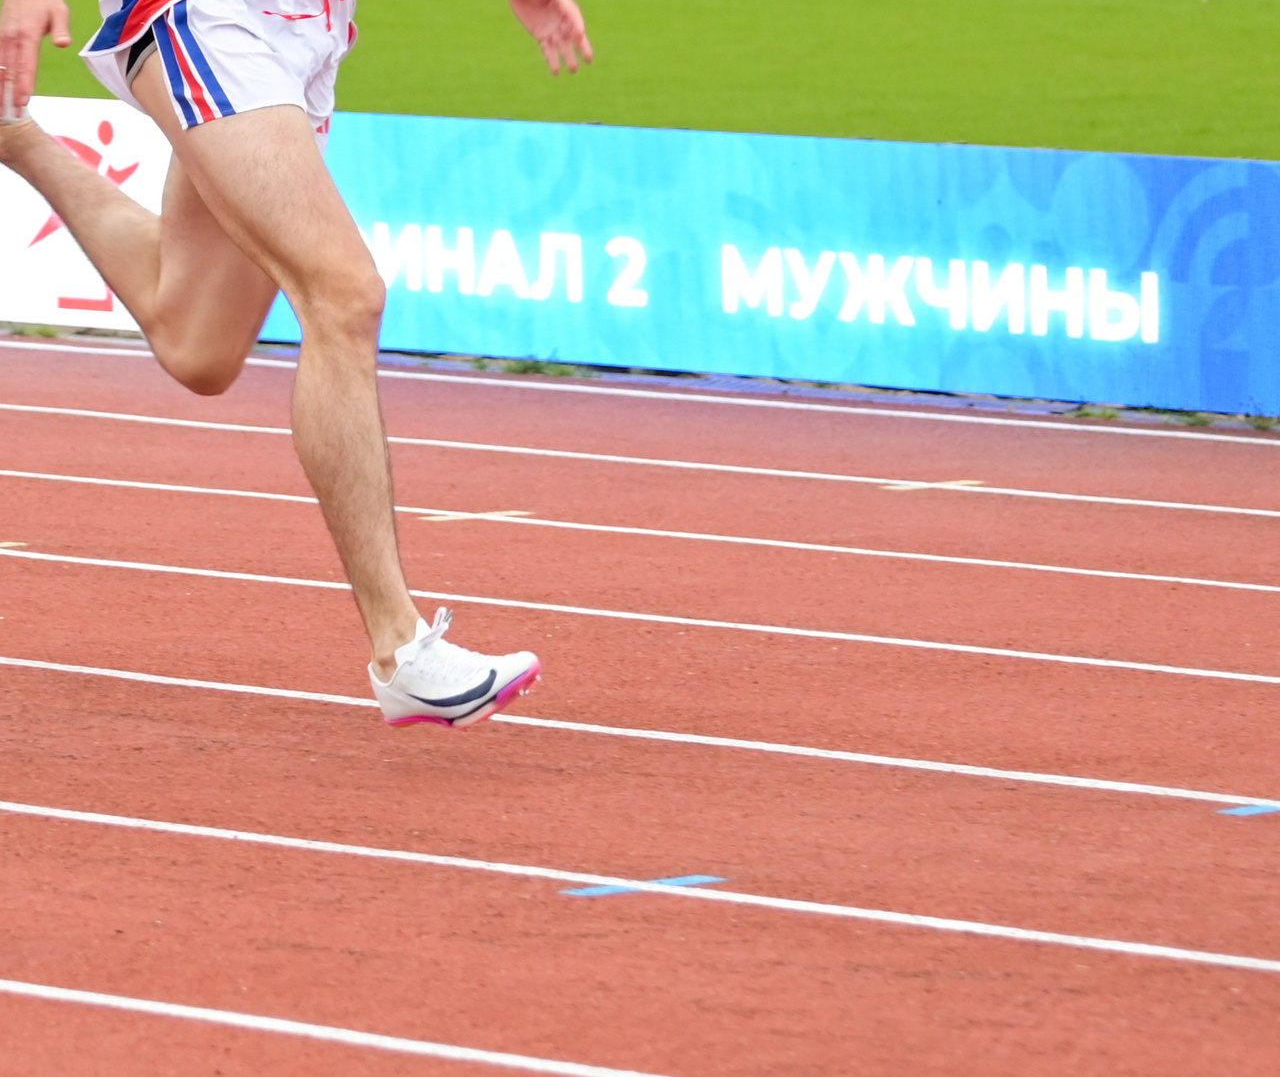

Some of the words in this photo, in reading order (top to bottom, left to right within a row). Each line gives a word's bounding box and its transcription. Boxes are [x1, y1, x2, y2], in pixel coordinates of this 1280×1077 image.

[358, 221, 584, 303] ИНАЛ
[604, 235, 649, 308] 2
[720, 243, 1160, 344] МУЖЧИНЫ
